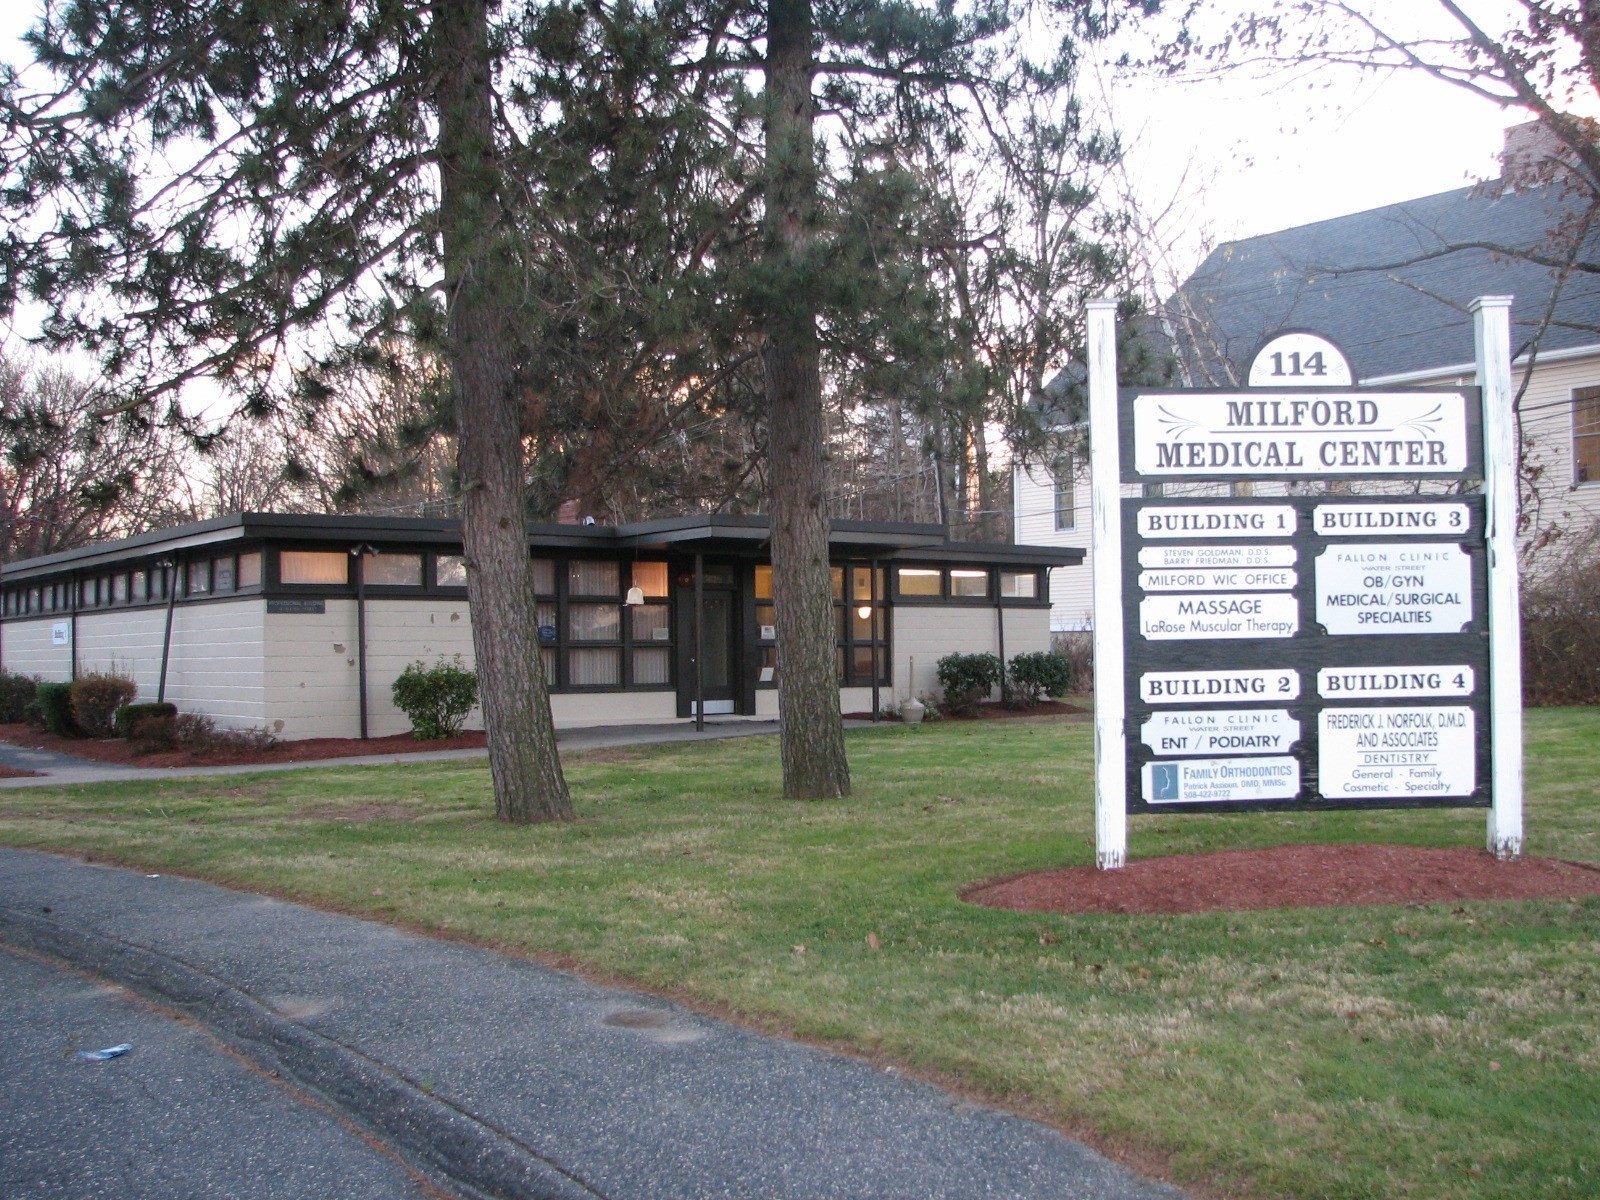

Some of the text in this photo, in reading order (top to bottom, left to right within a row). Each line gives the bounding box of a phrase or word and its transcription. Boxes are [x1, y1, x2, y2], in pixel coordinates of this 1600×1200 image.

[1270, 351, 1327, 376] 114
[1226, 400, 1378, 426] MILFORD
[1156, 441, 1447, 467] MEDICAL CENTER
[1148, 514, 1285, 530] BUILDING 1
[1322, 511, 1461, 528] BUILDING 3
[1338, 553, 1449, 562] FALLON CLINIC
[1148, 574, 1287, 586] MILFORD WIC OFFICE
[1363, 575, 1424, 588] OB/GYN
[1326, 593, 1461, 606] MEDICAL/SURGICAL
[1178, 600, 1261, 615] MASSAGE
[1358, 611, 1432, 624] SPECIALTIES
[1146, 619, 1293, 634] LaRose Muscular Therapy
[1149, 677, 1290, 695] BUILDING 2
[1326, 673, 1465, 690] BUILDING 4
[1164, 715, 1278, 724] FALLON CLINIC
[1327, 714, 1375, 729] FREDERICK
[1162, 737, 1187, 749] ENT
[1209, 735, 1281, 748] PODIATRY
[1357, 732, 1438, 747] AND ASSOCIATES
[1365, 754, 1430, 763] DENTISTRY
[1184, 766, 1292, 779] FAMILY ORTHODONTICS
[1352, 769, 1393, 779] General
[1409, 767, 1442, 780] Family
[1343, 783, 1389, 792] Cosmetic
[1405, 781, 1451, 793] Specialty
